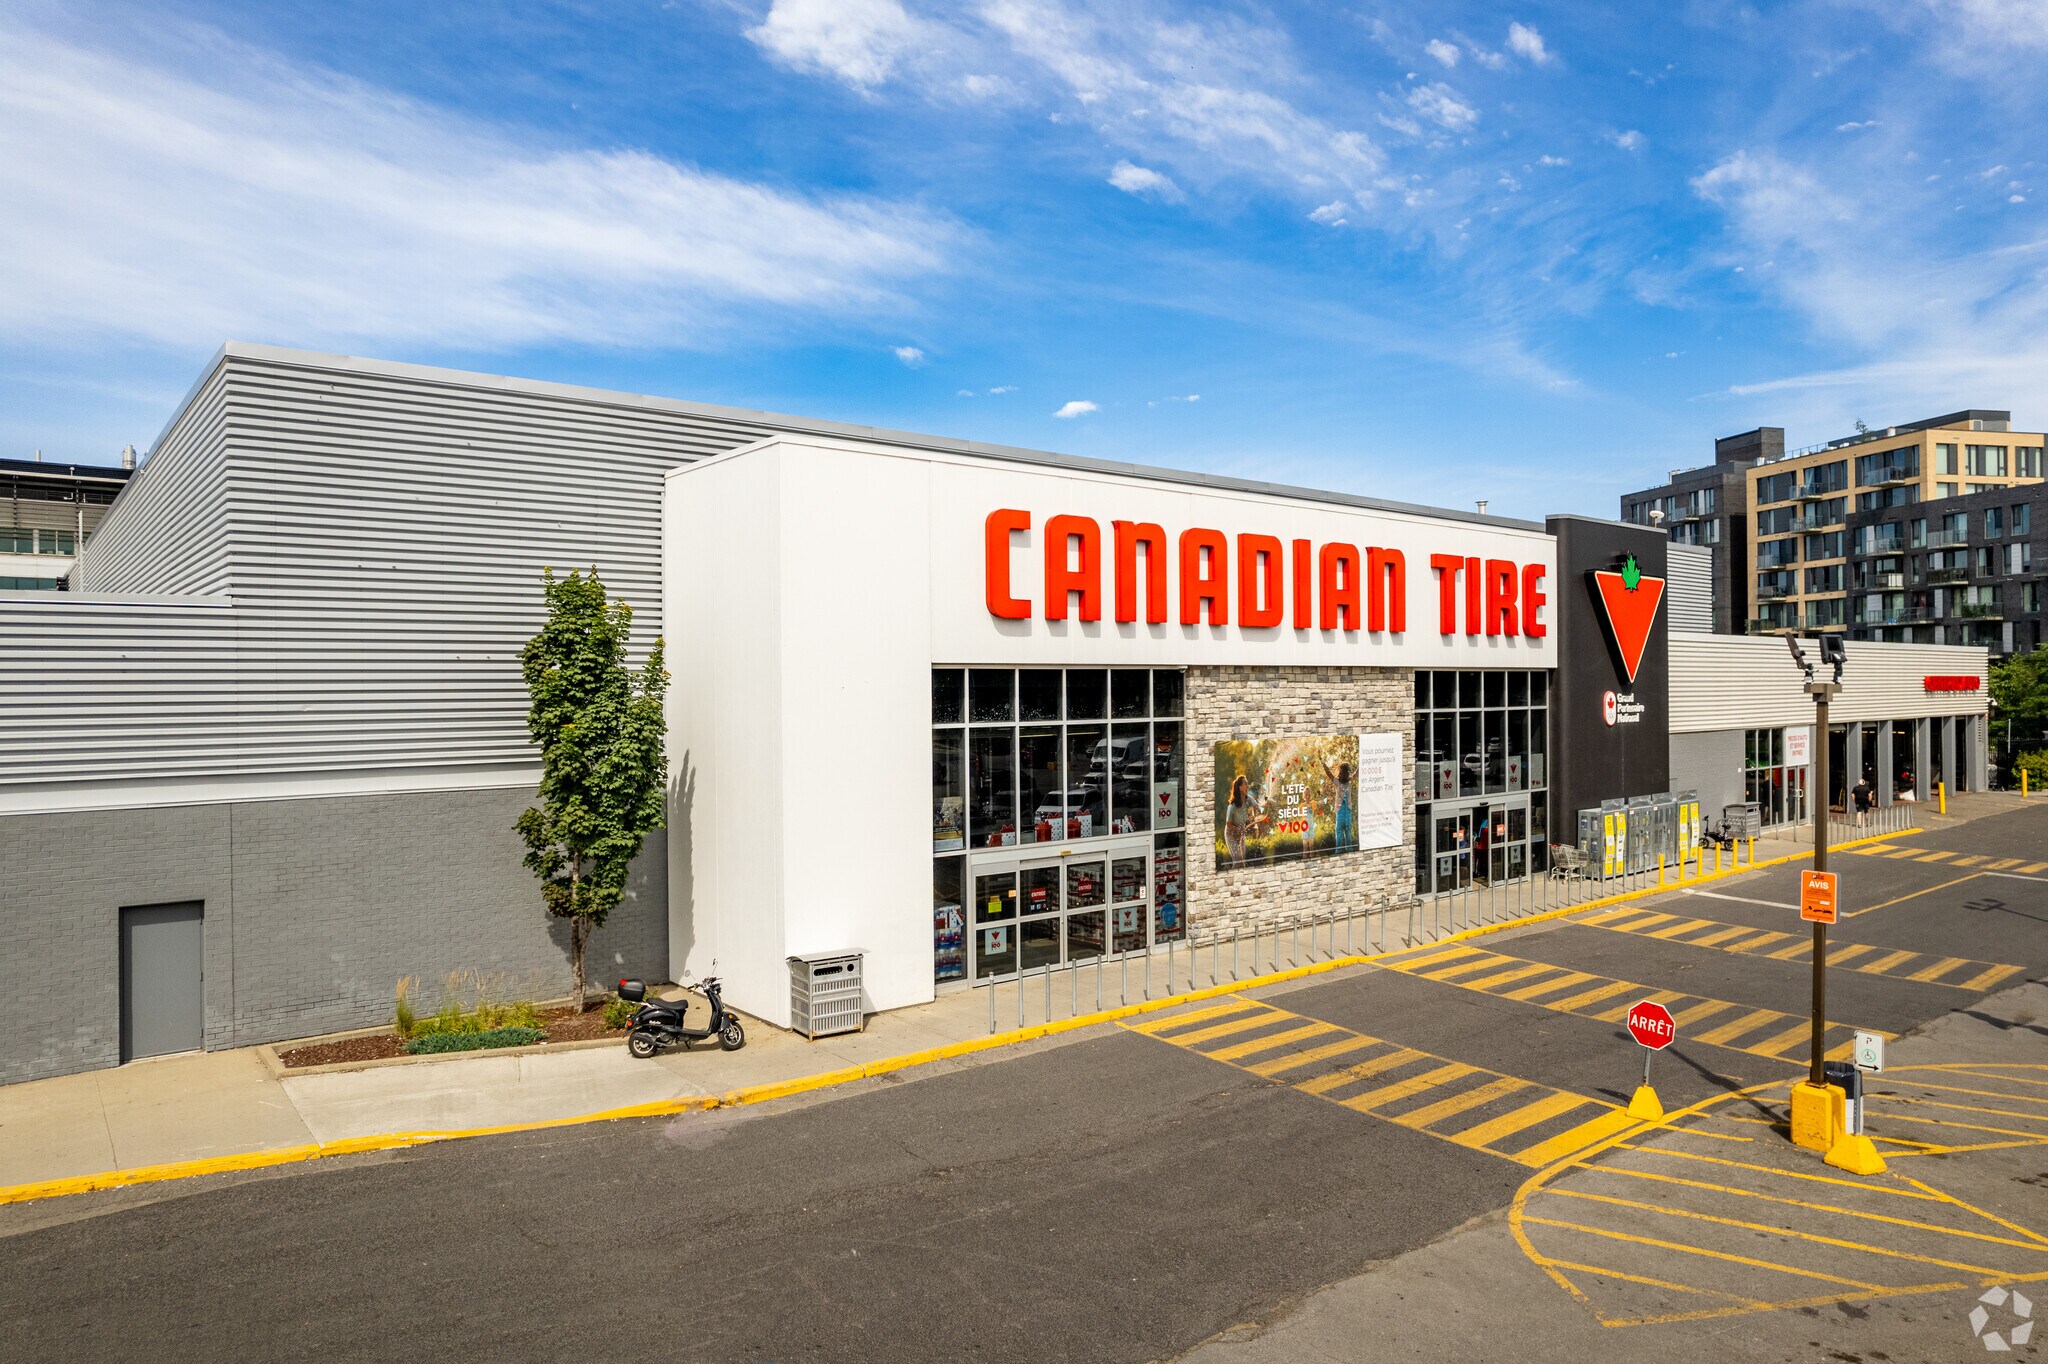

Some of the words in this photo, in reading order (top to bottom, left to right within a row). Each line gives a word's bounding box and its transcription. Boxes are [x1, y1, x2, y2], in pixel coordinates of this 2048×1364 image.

[985, 508, 1406, 633] CANADIAN
[1431, 553, 1547, 637] TIRE
[1361, 757, 1379, 766] gagner
[1281, 781, 1305, 795] L'ÉTÉ
[1361, 785, 1383, 793] Canadian
[1287, 795, 1300, 805] DU
[1158, 809, 1171, 818] 100
[1278, 806, 1308, 818] SIÈCLE
[1289, 820, 1309, 833] 100
[1808, 880, 1829, 890] AVIS
[1630, 1014, 1673, 1037] ARRÊT
